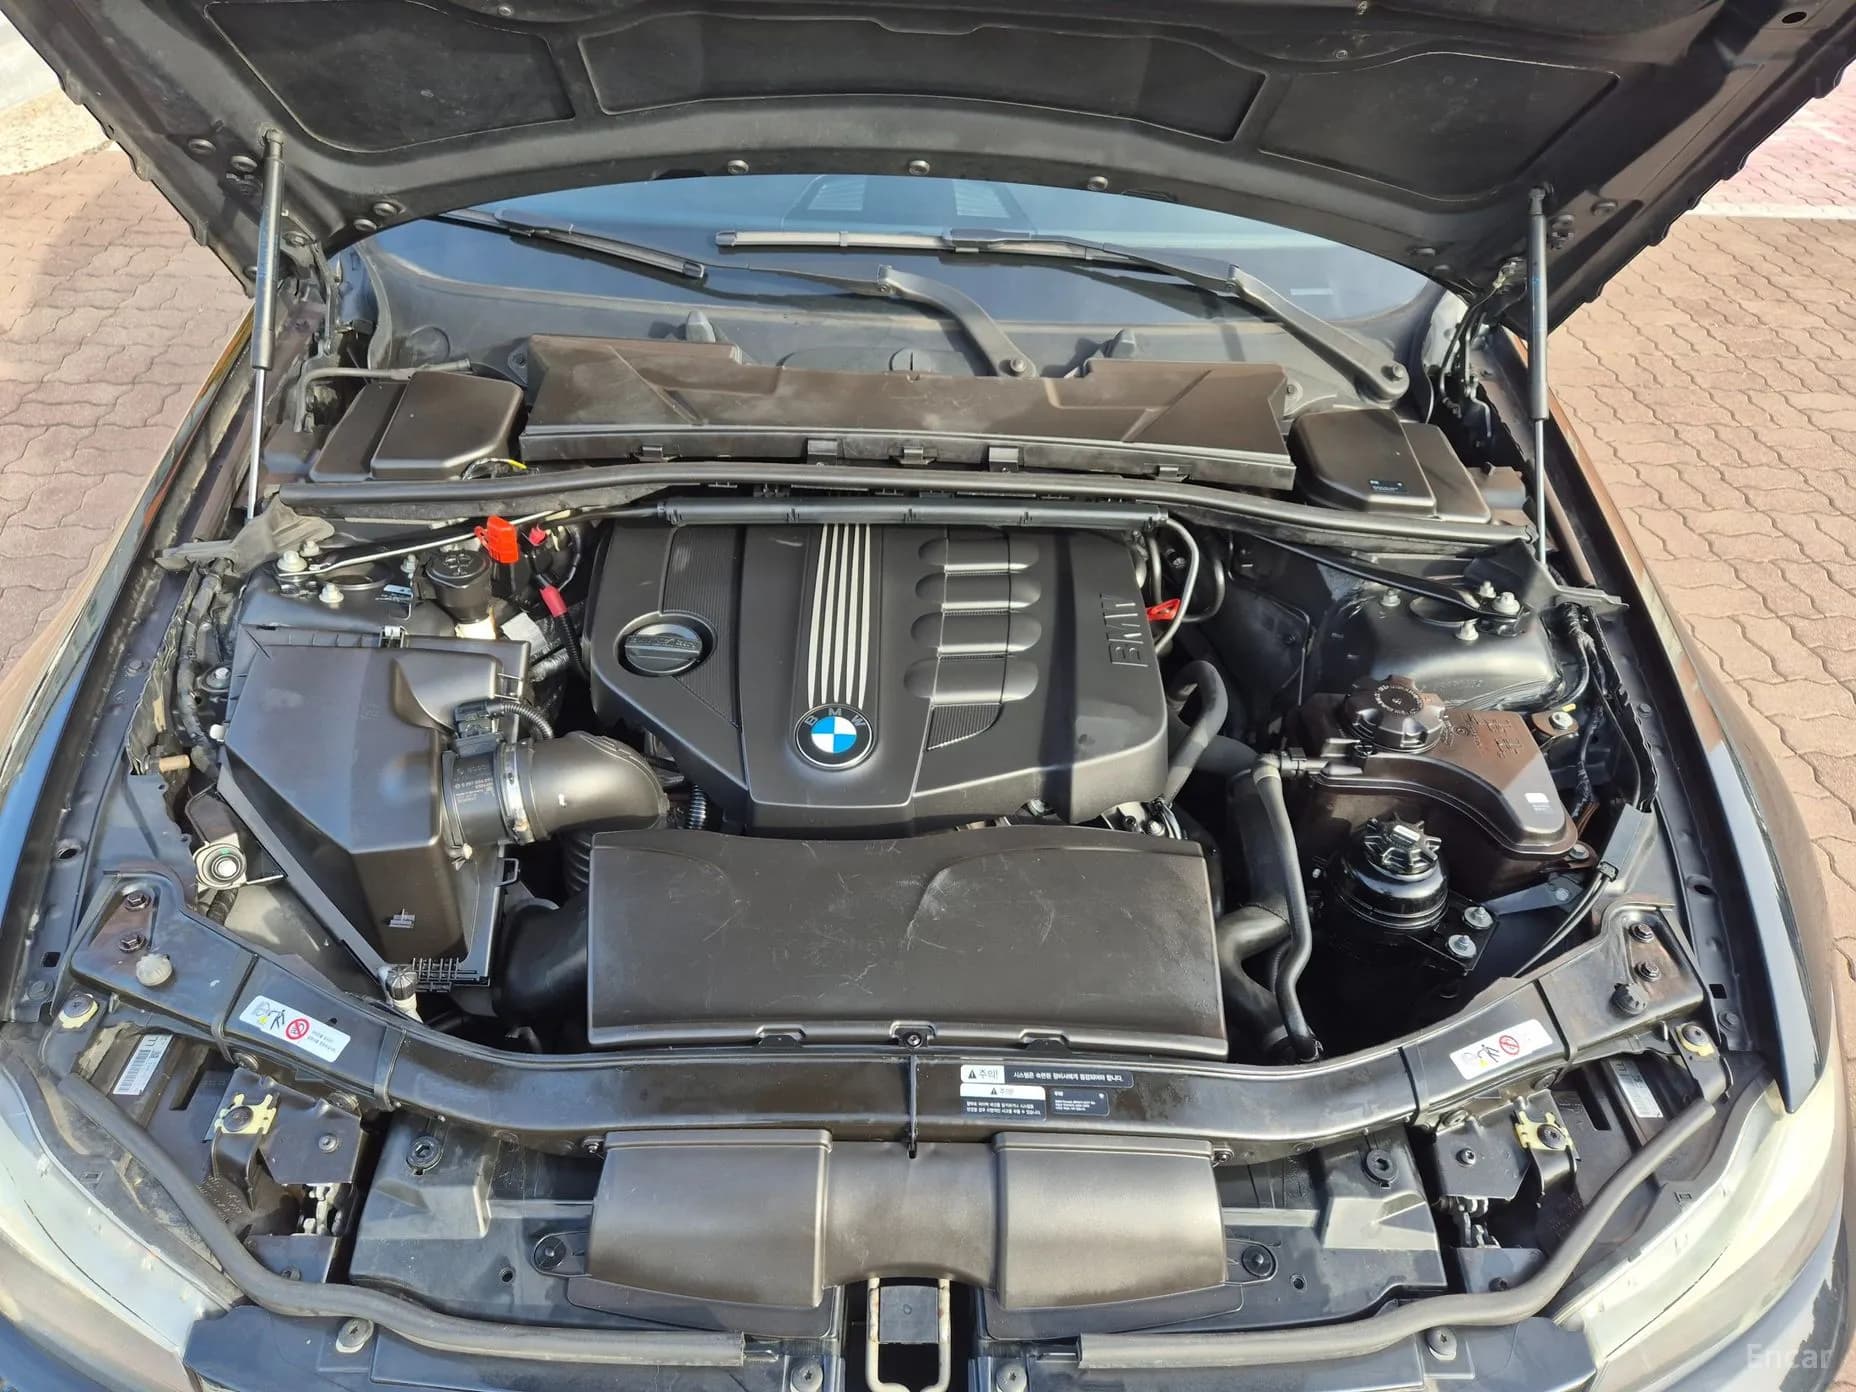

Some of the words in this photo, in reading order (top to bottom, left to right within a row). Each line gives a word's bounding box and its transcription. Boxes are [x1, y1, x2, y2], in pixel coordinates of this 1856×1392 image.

[1099, 592, 1149, 667] BMW
[804, 707, 866, 727] BMW
[978, 1069, 999, 1081] 주의!
